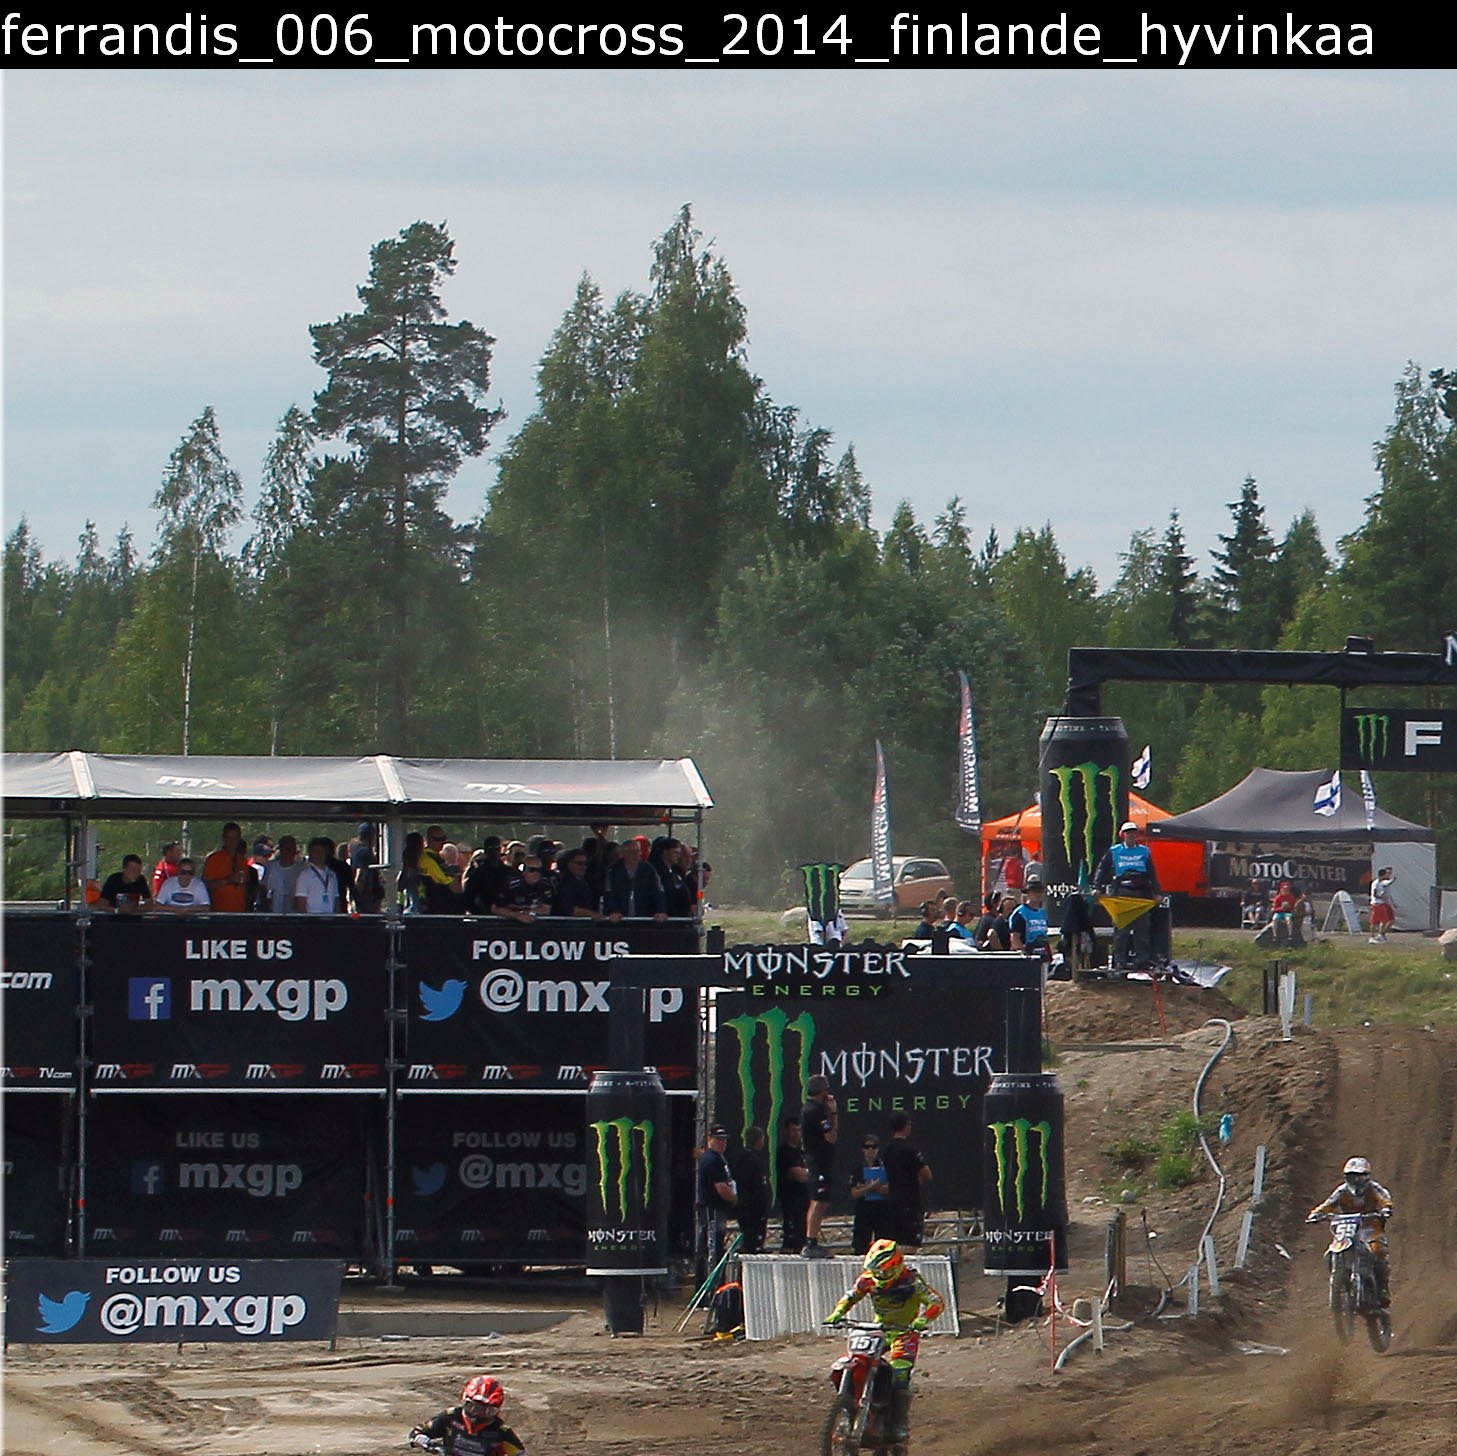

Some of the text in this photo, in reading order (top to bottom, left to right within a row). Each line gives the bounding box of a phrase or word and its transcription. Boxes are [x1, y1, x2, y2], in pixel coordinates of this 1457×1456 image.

[184, 939, 294, 960] LIKE US
[471, 940, 631, 961] FOLLOW US
[723, 946, 912, 980] MONSTER
[190, 978, 349, 1021] mxgp
[479, 968, 684, 1023] @mxp
[752, 984, 883, 996] ENERGY
[820, 1041, 996, 1088] MONSTER
[846, 1094, 971, 1112] ENERGY
[175, 1131, 261, 1149] LIKE US
[452, 1132, 577, 1149] FOLLOW US
[178, 1162, 304, 1197] mxgp
[106, 1266, 241, 1285] FOLLOW US
[100, 1292, 307, 1336] @mxgp
[849, 1335, 880, 1352] 151
